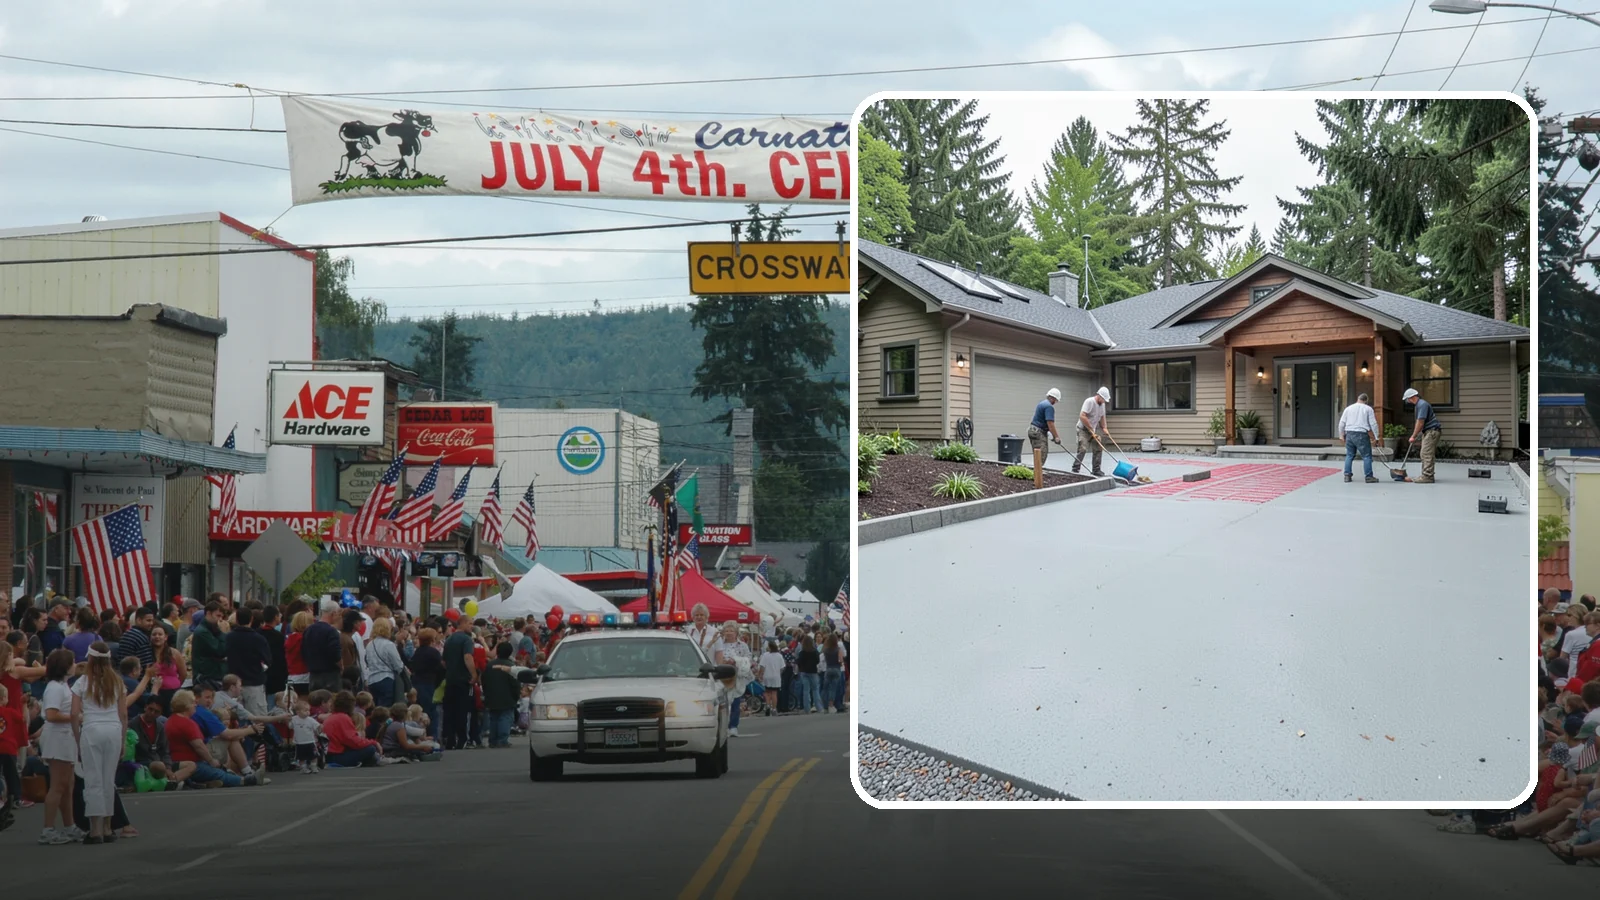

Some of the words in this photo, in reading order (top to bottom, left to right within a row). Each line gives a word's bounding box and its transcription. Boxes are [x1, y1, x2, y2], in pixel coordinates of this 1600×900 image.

[481, 141, 605, 192] JULY
[632, 150, 746, 198] 4th.
[697, 254, 850, 280] CROSSWA
[282, 380, 374, 420] ACE
[405, 409, 457, 421] CEDAR
[461, 409, 485, 421] LOG
[283, 421, 371, 437] Hardware
[416, 428, 477, 447] Coca-Cola
[353, 466, 387, 480] Simpl
[83, 485, 93, 495] St.
[96, 485, 124, 495] Vincent
[126, 485, 135, 495] de
[137, 486, 155, 496] Paul
[699, 535, 730, 543] GLASS
